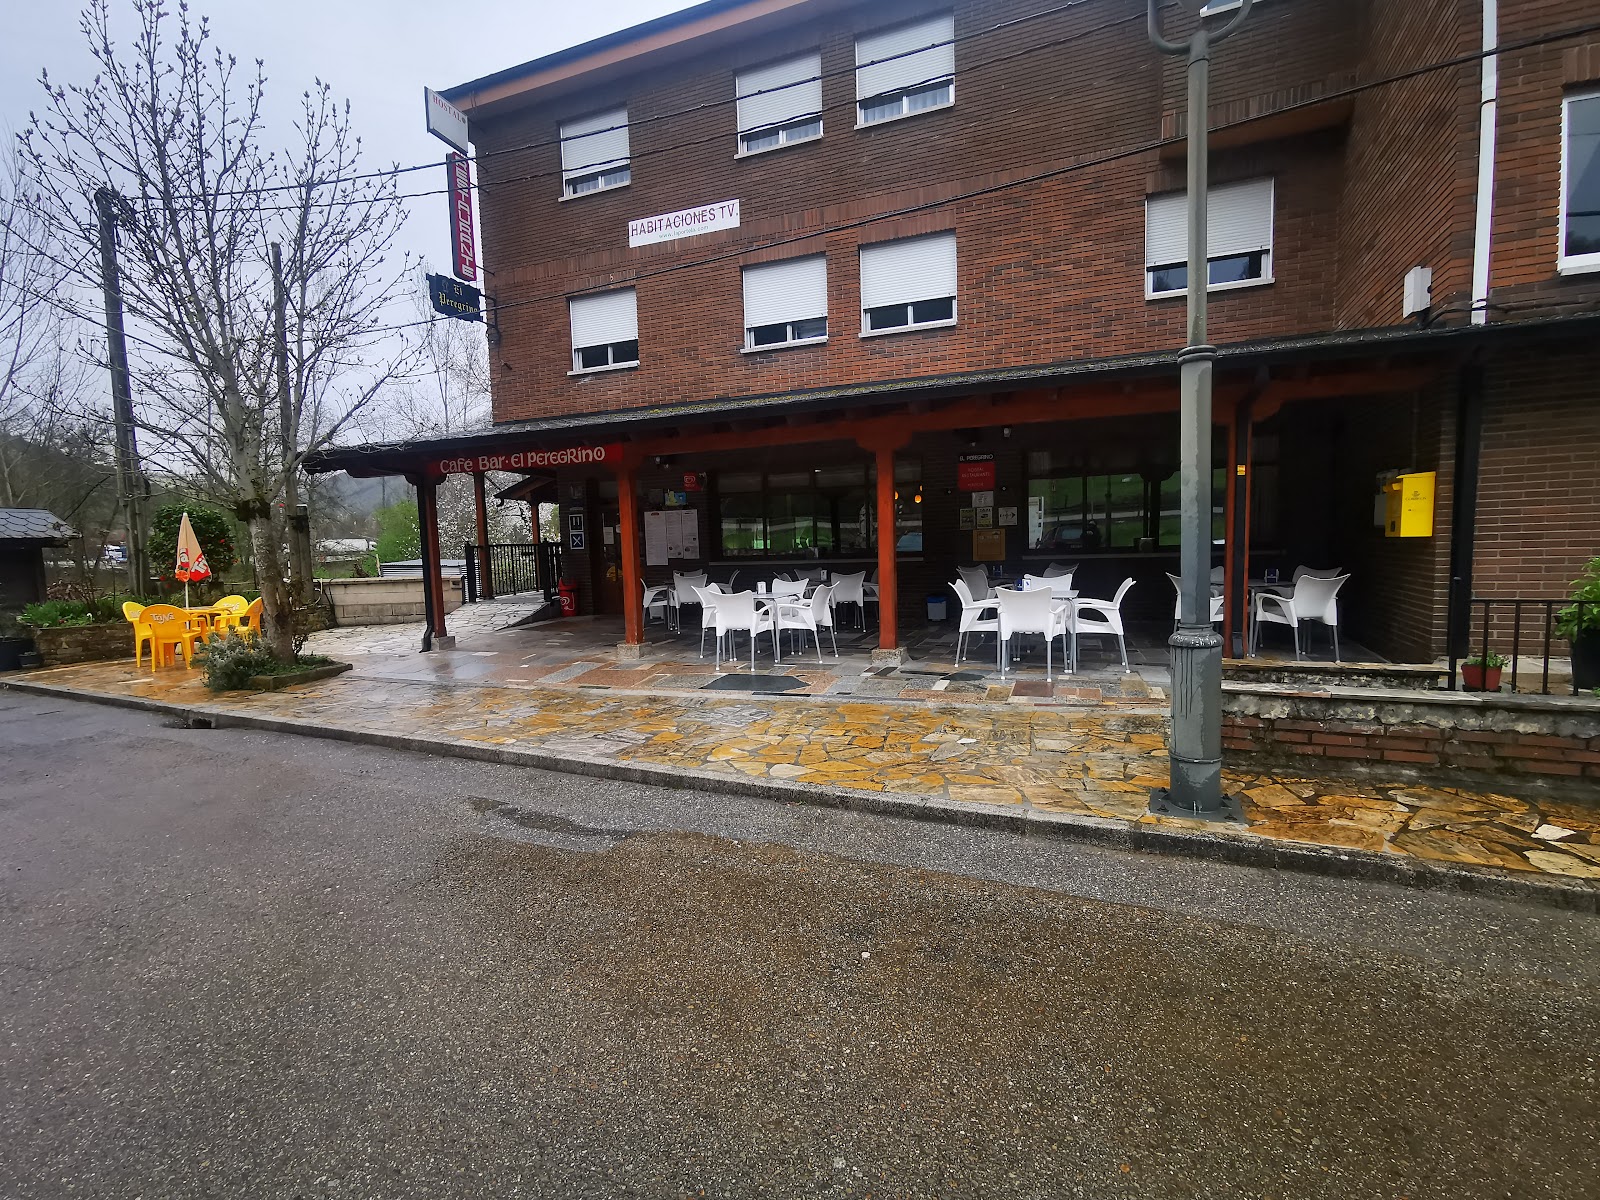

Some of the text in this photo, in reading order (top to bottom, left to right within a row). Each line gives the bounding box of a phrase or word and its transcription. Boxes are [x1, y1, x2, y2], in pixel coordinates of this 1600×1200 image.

[454, 154, 475, 279] RESTAURANTE
[631, 207, 716, 237] HABITACIONES
[439, 291, 478, 313] Peregrino
[439, 458, 473, 474] Café
[478, 455, 505, 471] Bar
[511, 452, 524, 468] El
